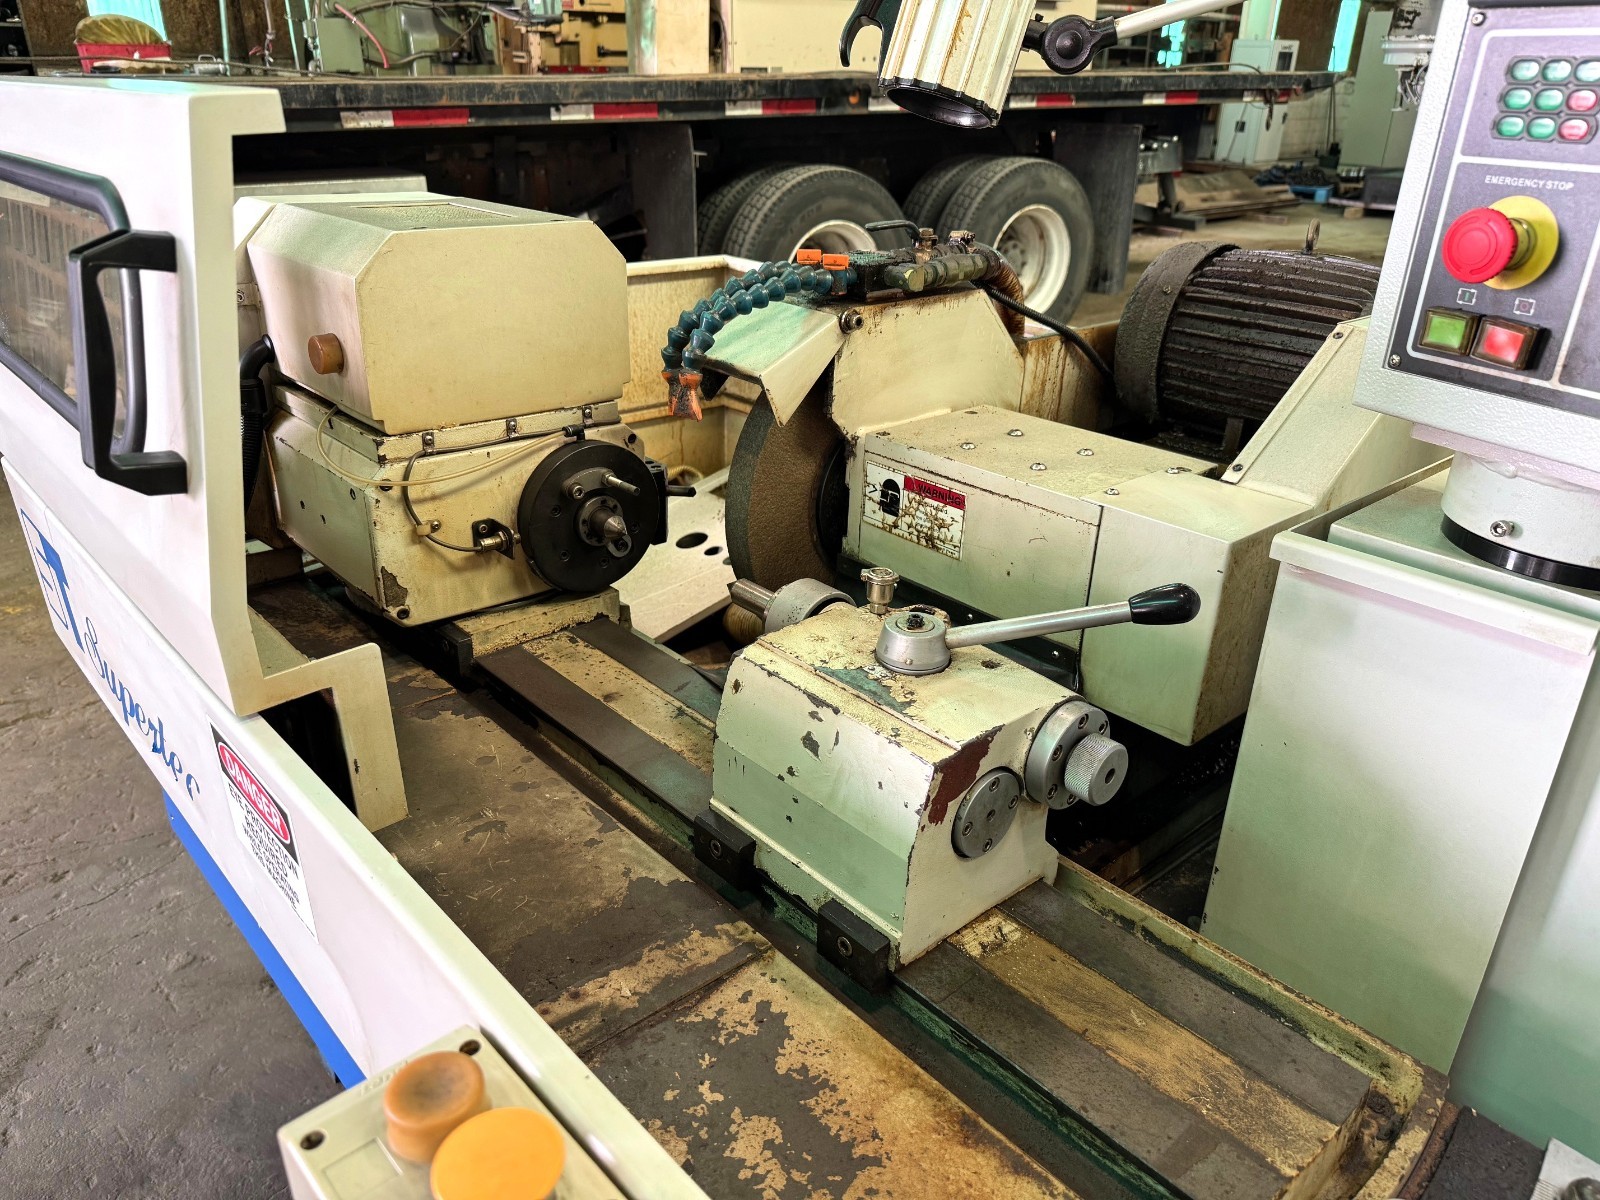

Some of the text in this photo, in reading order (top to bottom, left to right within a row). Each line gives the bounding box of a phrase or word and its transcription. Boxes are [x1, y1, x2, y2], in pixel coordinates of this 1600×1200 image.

[1485, 175, 1575, 191] EMERGENCY STOP
[918, 484, 962, 506] WARNING
[222, 747, 284, 837] DANGER
[228, 782, 299, 880] EYE PROTECTION
[241, 822, 300, 904] WHILE OPERATING
[244, 814, 288, 879] REQUIRED
[250, 842, 297, 909] THIS MACHINE
